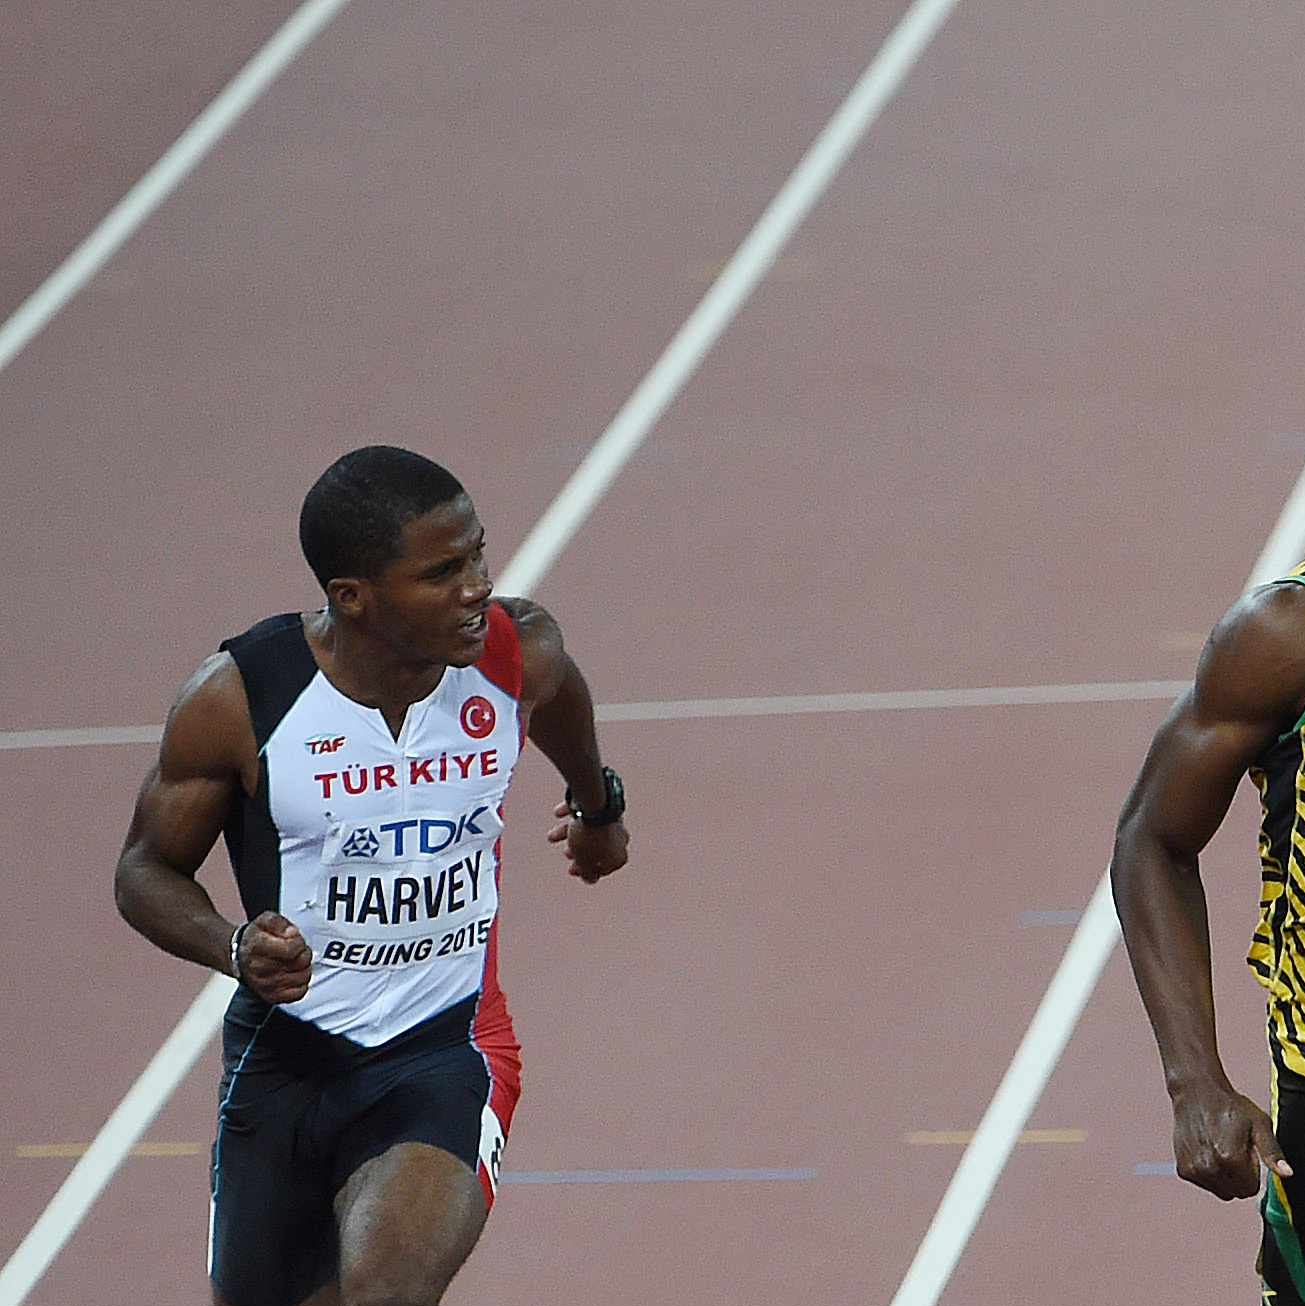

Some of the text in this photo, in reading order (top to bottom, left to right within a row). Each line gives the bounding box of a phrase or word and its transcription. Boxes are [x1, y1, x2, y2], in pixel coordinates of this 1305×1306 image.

[308, 736, 346, 755] TAF
[314, 749, 498, 798] TÜRKİYE
[380, 806, 488, 857] TDK
[326, 850, 483, 924] HARVEY
[323, 918, 491, 966] BEIJING 2015
